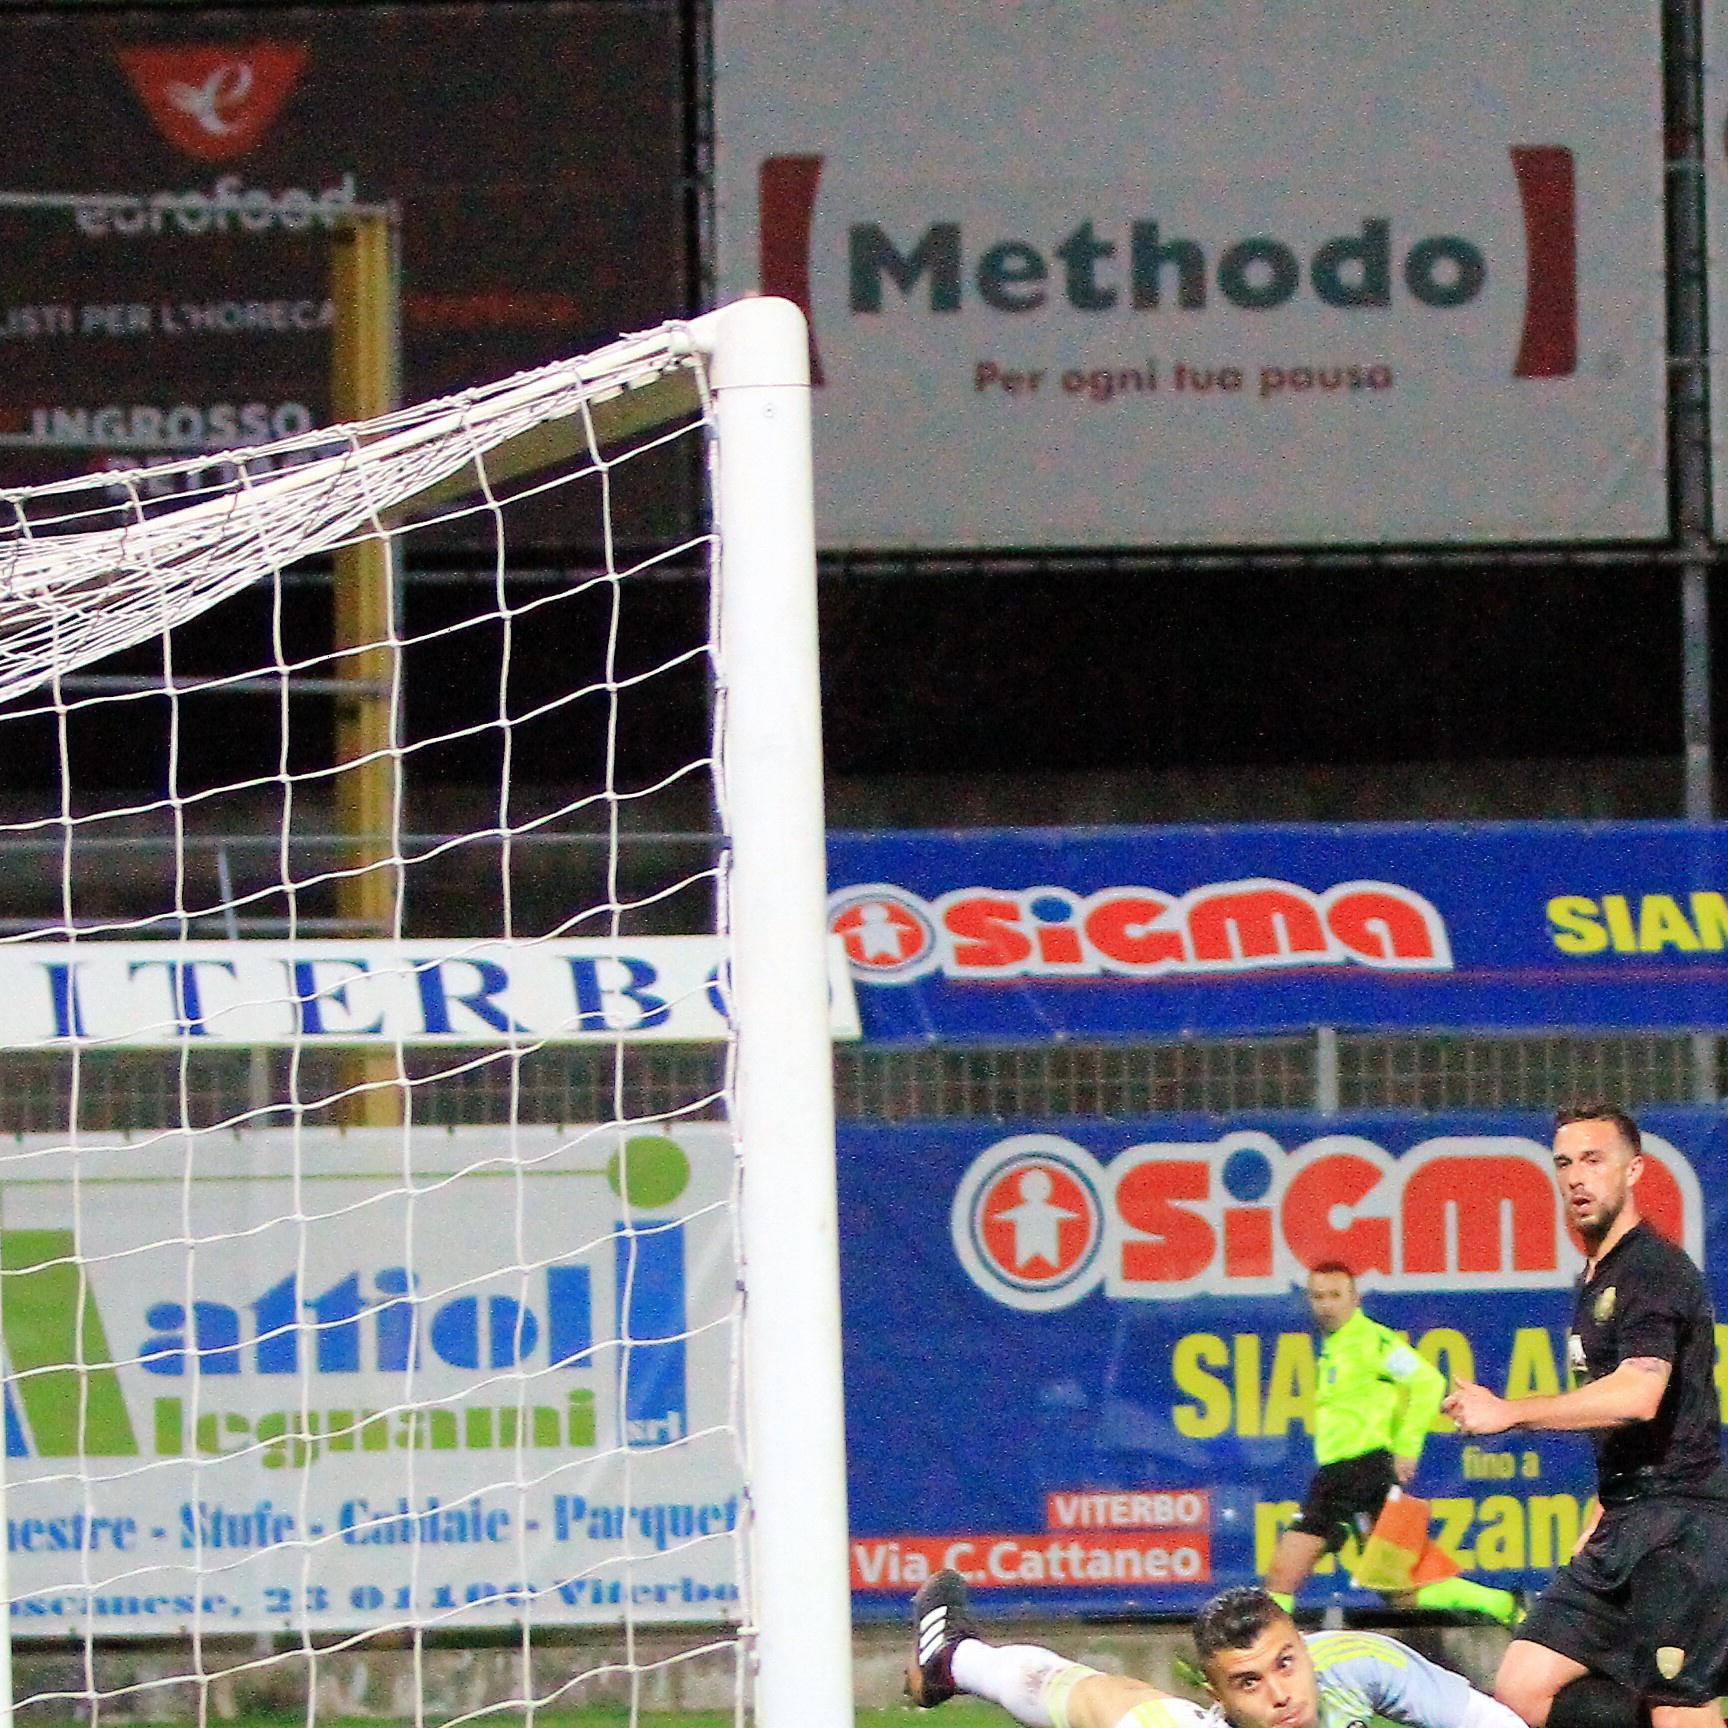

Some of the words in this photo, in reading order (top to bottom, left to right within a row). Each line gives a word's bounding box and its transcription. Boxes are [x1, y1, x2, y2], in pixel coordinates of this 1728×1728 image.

[847, 216, 1488, 315] Methodo
[83, 304, 151, 335] PER
[974, 358, 1044, 396] Per
[1060, 357, 1159, 403] ogni
[1172, 358, 1244, 395] tua
[1258, 360, 1395, 401] pausa
[29, 402, 312, 446] INGROSSO
[1172, 1327, 1476, 1439] SIAO
[153, 1388, 598, 1469] legnami
[1462, 1446, 1515, 1479] fino
[1522, 1451, 1540, 1479] a
[180, 1498, 294, 1551] Stufe
[553, 1494, 739, 1551] Parquet
[1055, 1494, 1203, 1526] VITERBO
[853, 1542, 930, 1584] Via
[943, 1541, 1202, 1581] C.Cattaneo
